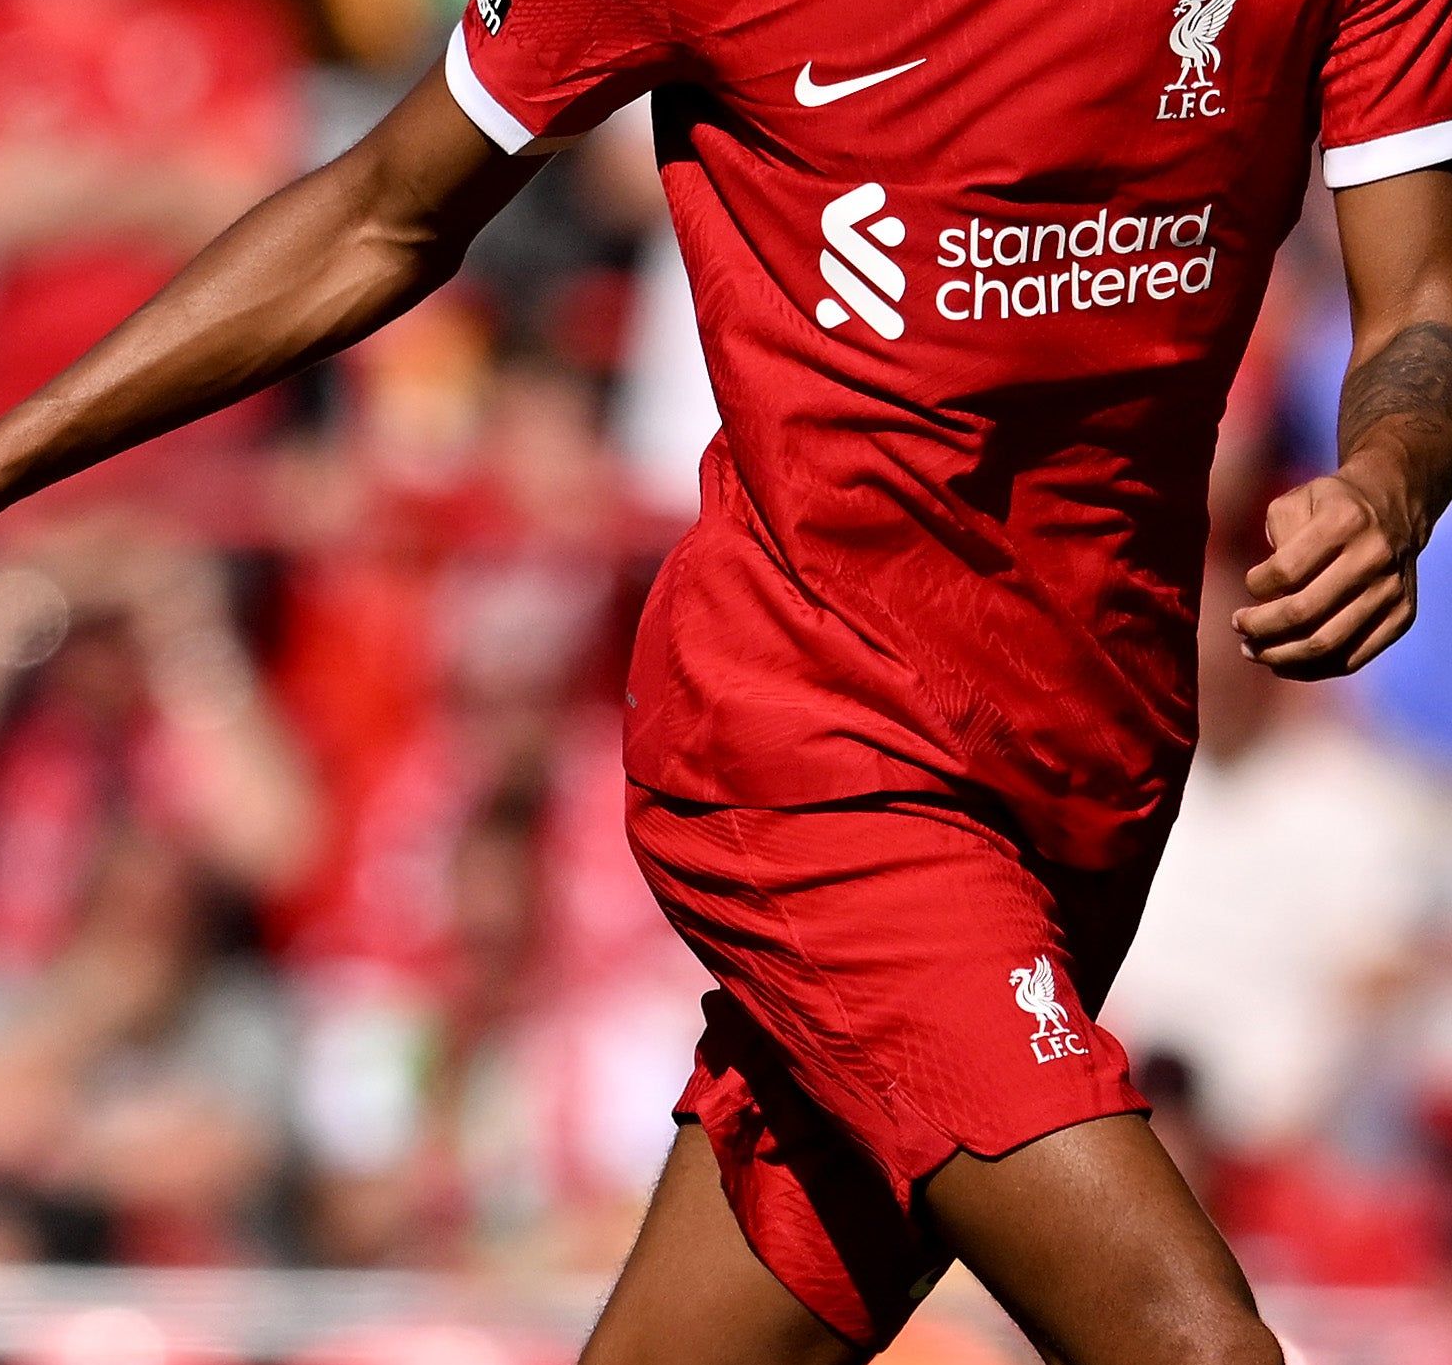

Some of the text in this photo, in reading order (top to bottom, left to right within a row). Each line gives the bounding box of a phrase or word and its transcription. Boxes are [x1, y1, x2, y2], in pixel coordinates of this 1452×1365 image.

[1156, 90, 1226, 120] L.F.C.
[936, 203, 1213, 269] standard
[935, 246, 1217, 321] chartered
[1030, 1033, 1089, 1064] L.F.C.
